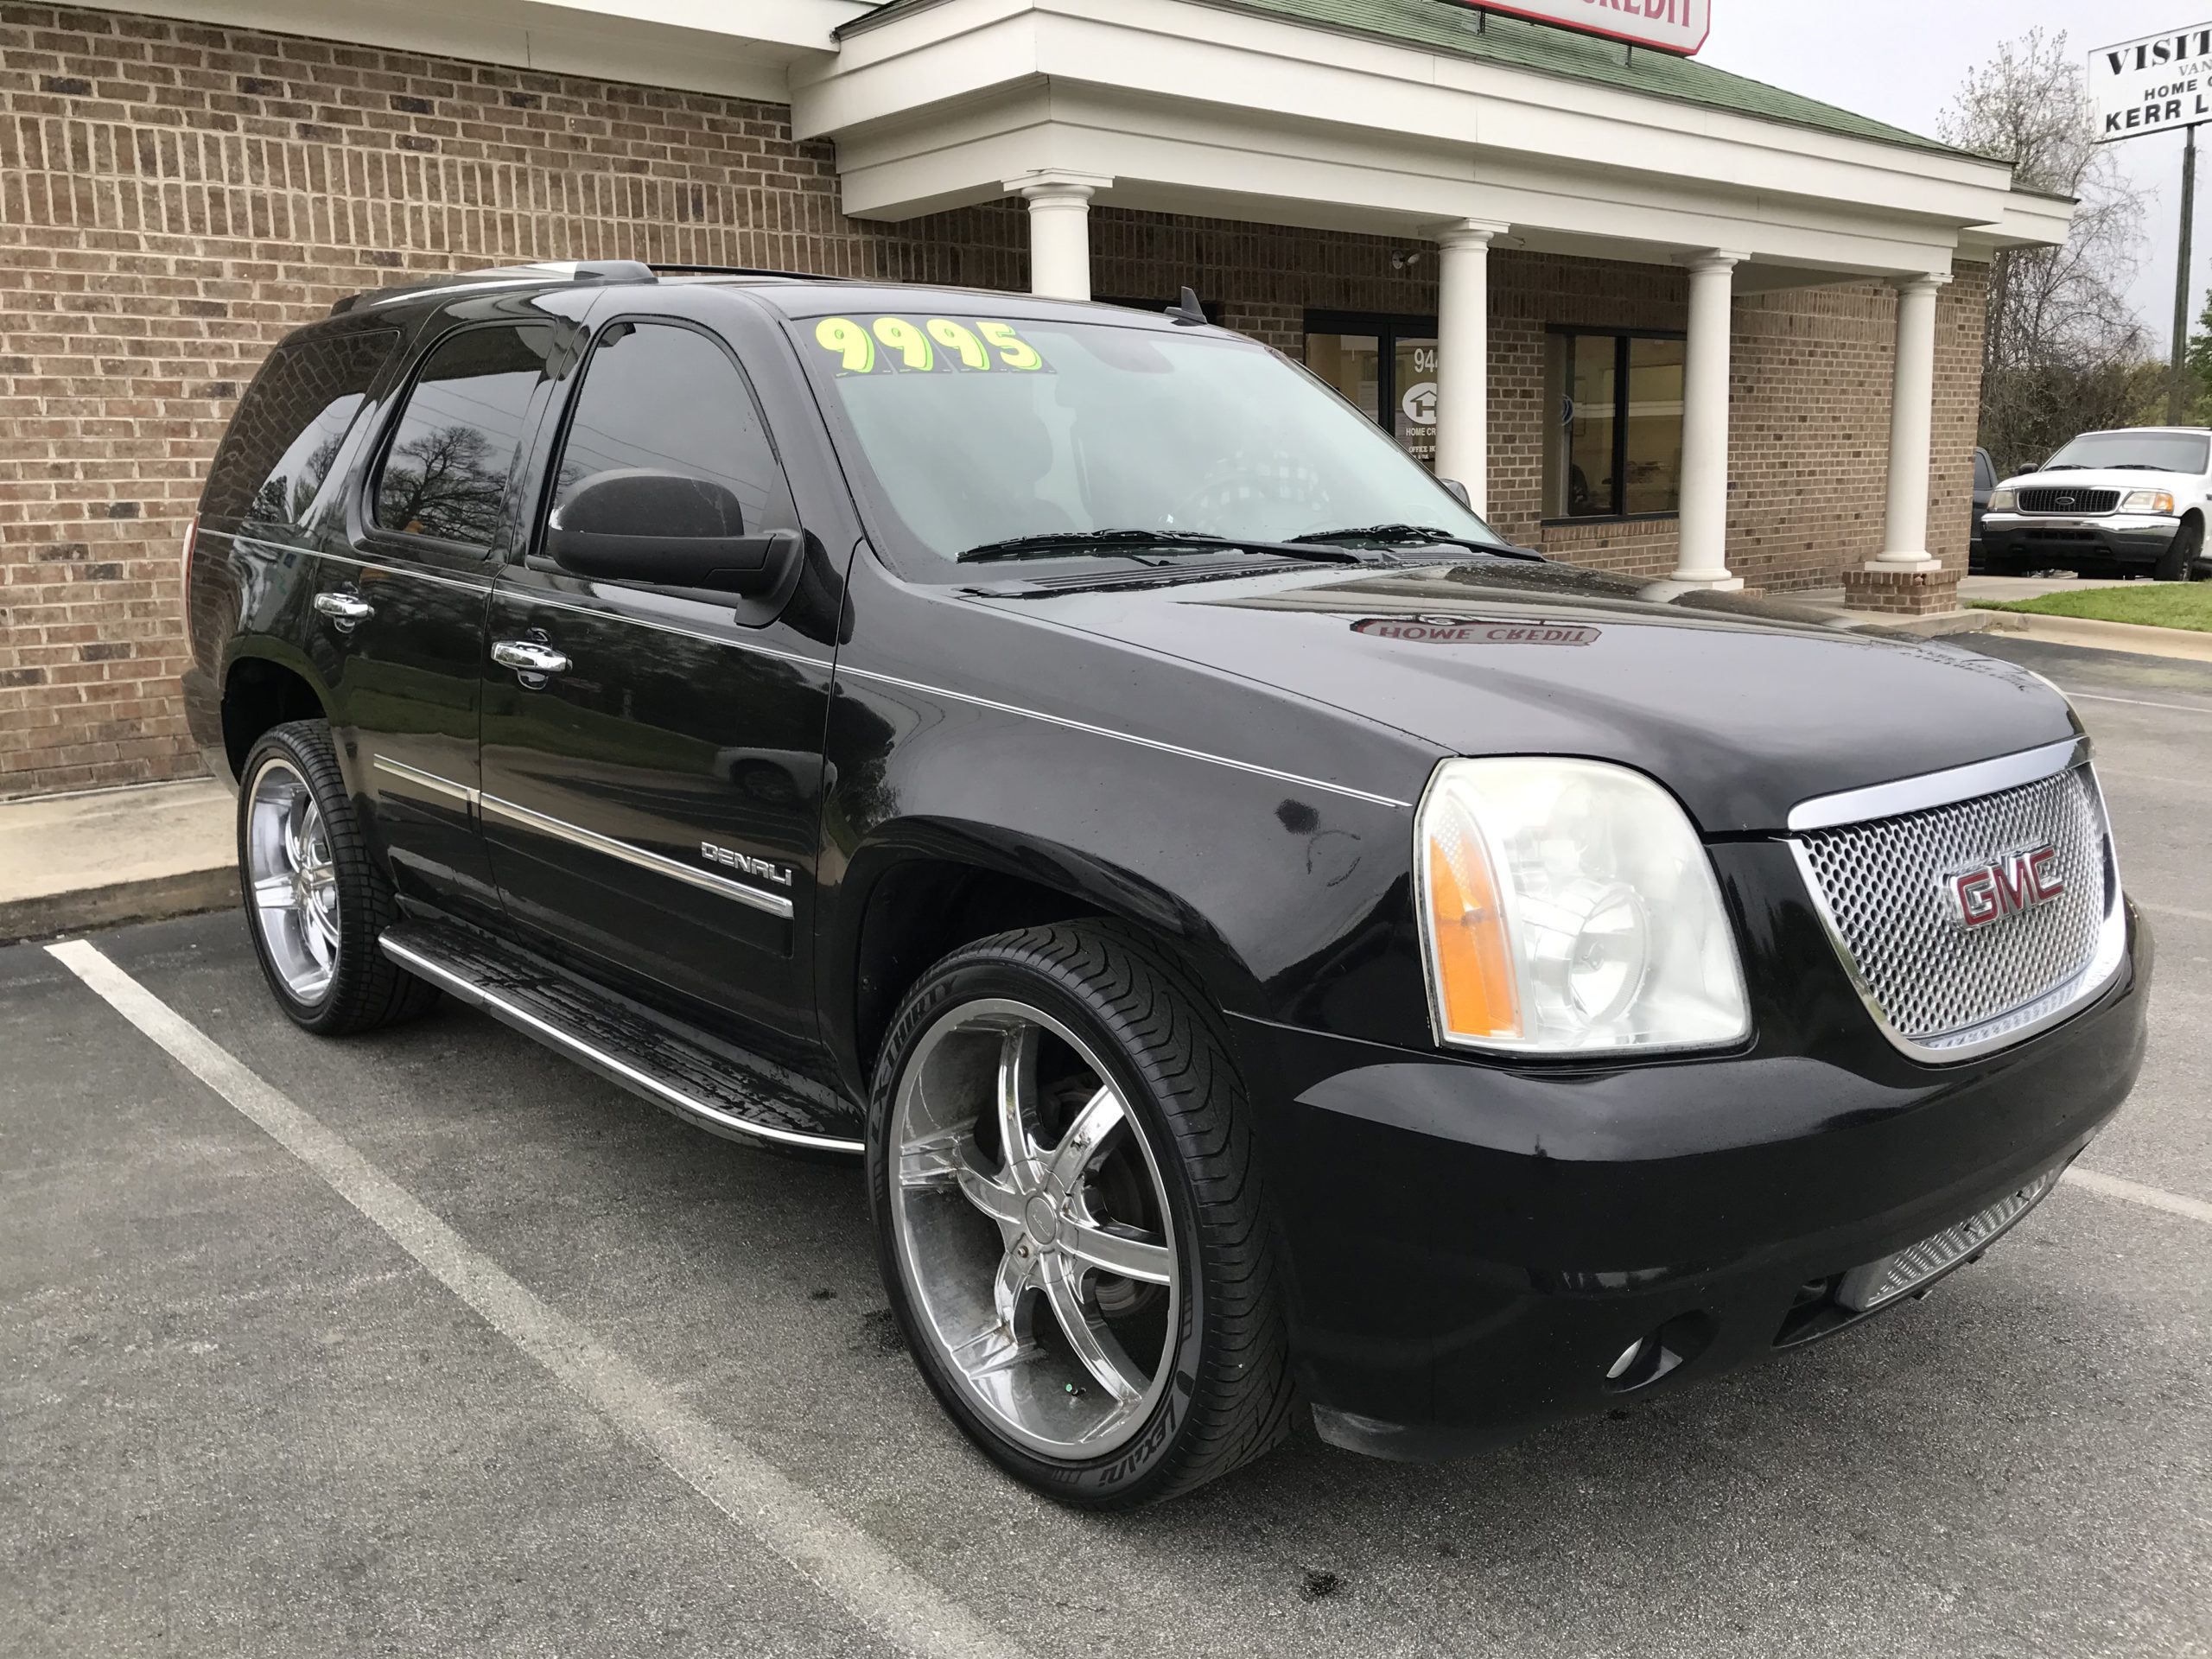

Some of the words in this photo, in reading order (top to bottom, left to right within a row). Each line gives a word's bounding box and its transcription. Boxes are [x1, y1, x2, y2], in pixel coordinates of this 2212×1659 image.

[2145, 79, 2198, 101] HOME
[2106, 99, 2182, 133] KERR
[2196, 93, 2212, 115] L
[816, 317, 1042, 373] 9995
[1414, 347, 1438, 373] 94
[1406, 427, 1426, 436] HOME
[1427, 427, 1436, 436] CR
[701, 841, 792, 887] DENALI
[1951, 844, 2066, 930] GMC
